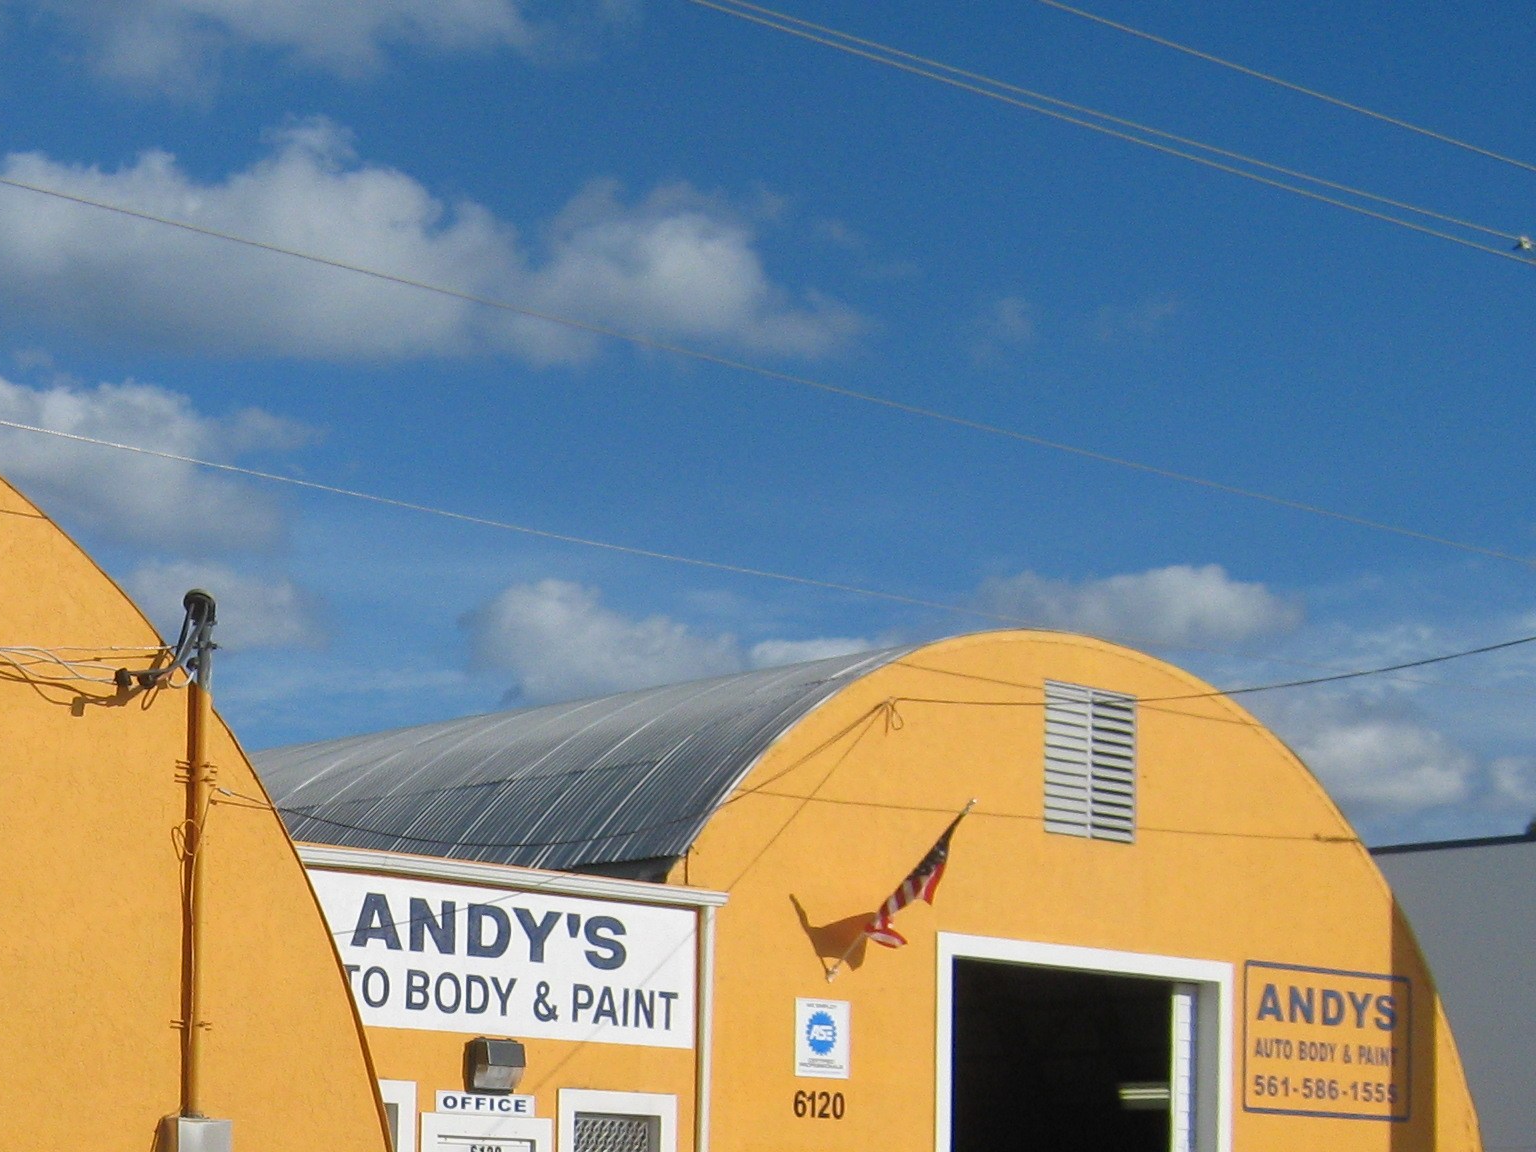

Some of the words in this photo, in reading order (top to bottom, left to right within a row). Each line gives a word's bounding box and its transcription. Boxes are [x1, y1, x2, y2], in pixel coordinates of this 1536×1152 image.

[350, 892, 628, 970] ANDY'S
[405, 969, 518, 1016] BODY
[533, 981, 559, 1023] &
[571, 984, 679, 1031] PAINT
[1256, 983, 1399, 1032] ANDYS
[1254, 1037, 1293, 1061] AUTO
[1299, 1040, 1337, 1063] BODY
[1343, 1044, 1353, 1064] &
[1358, 1044, 1399, 1067] PAINT
[1254, 1074, 1399, 1102] 561-586-1555
[442, 1095, 527, 1113] OFFICE
[793, 1090, 845, 1120] 6120
